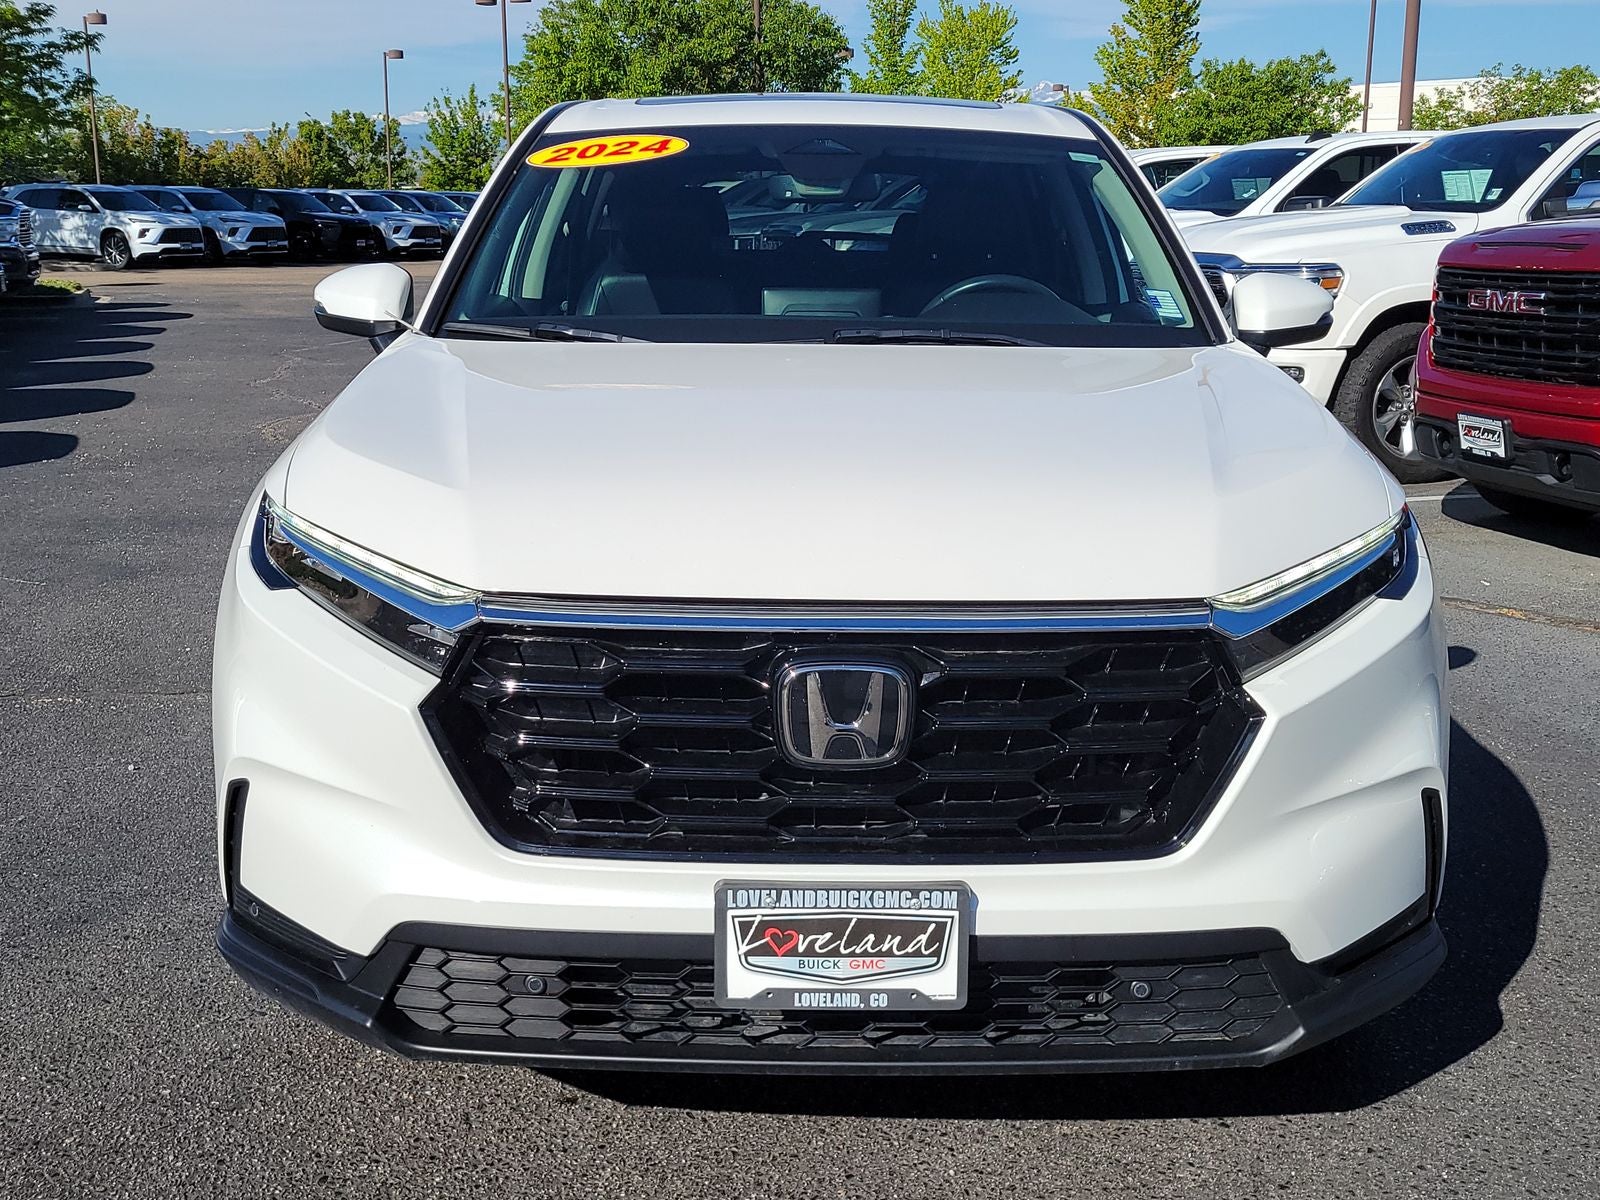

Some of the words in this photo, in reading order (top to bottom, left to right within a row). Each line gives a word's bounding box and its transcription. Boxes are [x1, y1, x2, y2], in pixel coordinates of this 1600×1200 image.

[542, 139, 672, 163] 2024
[1467, 289, 1546, 315] GMC
[727, 889, 958, 909] LOVELANDBUICKGMCCOM
[738, 914, 939, 957] Loveland
[798, 959, 840, 970] BUICK
[849, 959, 886, 970] GMC
[794, 992, 865, 1009] LOVELAND,
[869, 992, 888, 1008] CO
